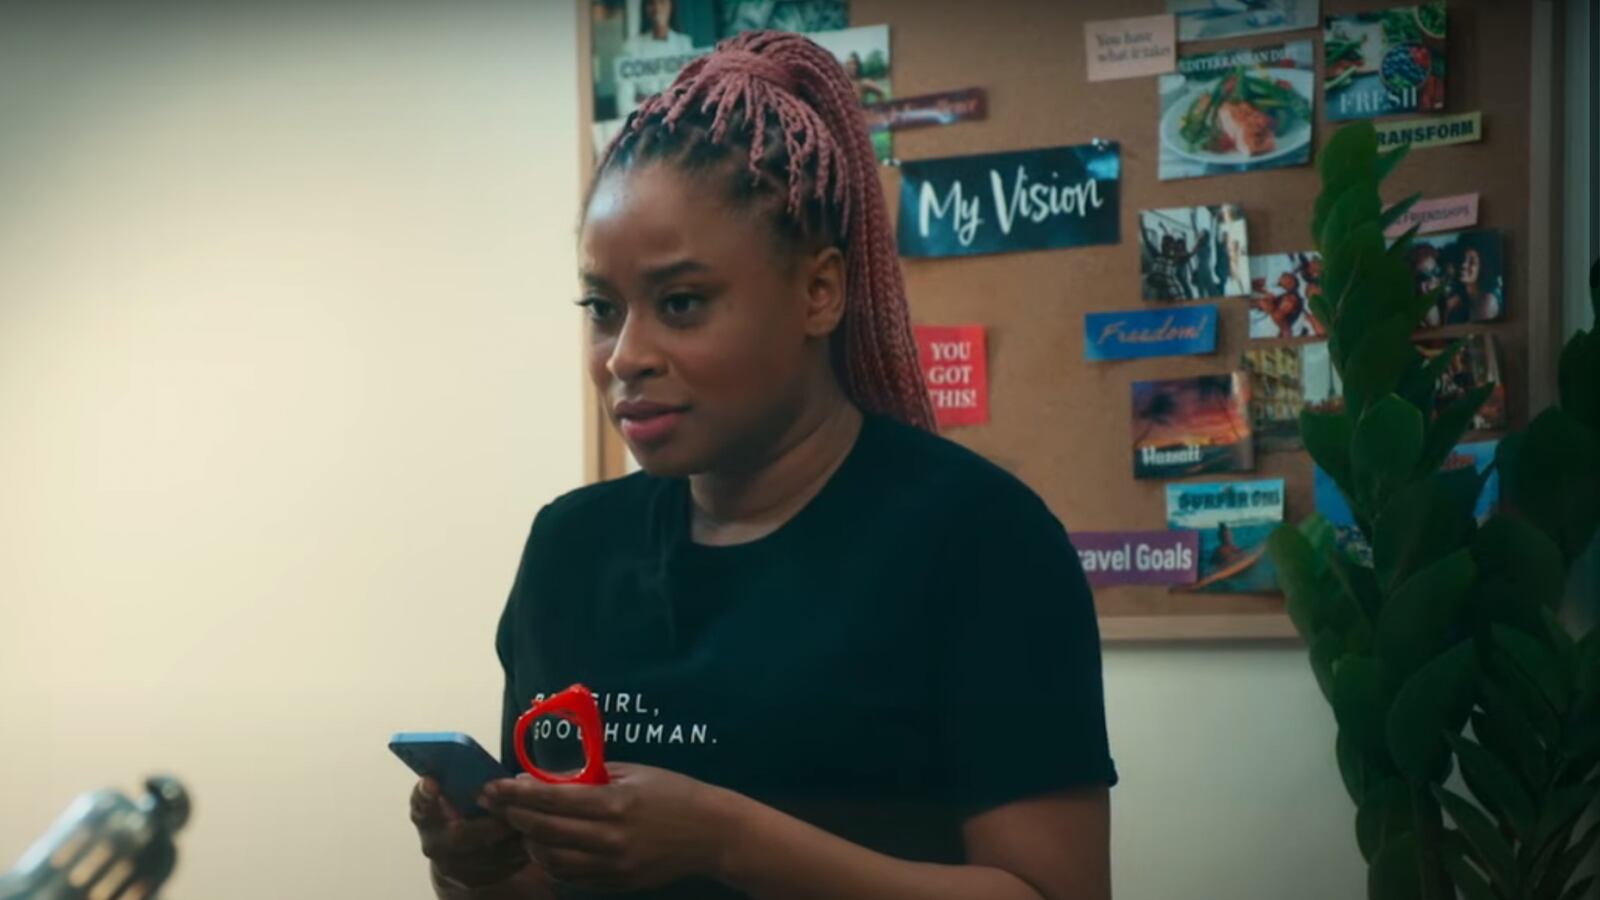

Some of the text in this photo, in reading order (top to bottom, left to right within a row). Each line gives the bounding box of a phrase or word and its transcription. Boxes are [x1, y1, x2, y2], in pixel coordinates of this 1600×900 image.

[1096, 31, 1152, 47] You have
[1098, 47, 1127, 62] what
[619, 56, 688, 79] CONFID
[1340, 86, 1417, 113] FRESH
[1376, 119, 1474, 145] RANSFORM
[918, 164, 1104, 246] My Vision
[1097, 314, 1207, 345] Freedom!
[929, 341, 972, 362] YOU
[928, 364, 974, 384] GOT
[1077, 542, 1192, 571] avel Goals
[604, 722, 718, 744] HUMAN.
